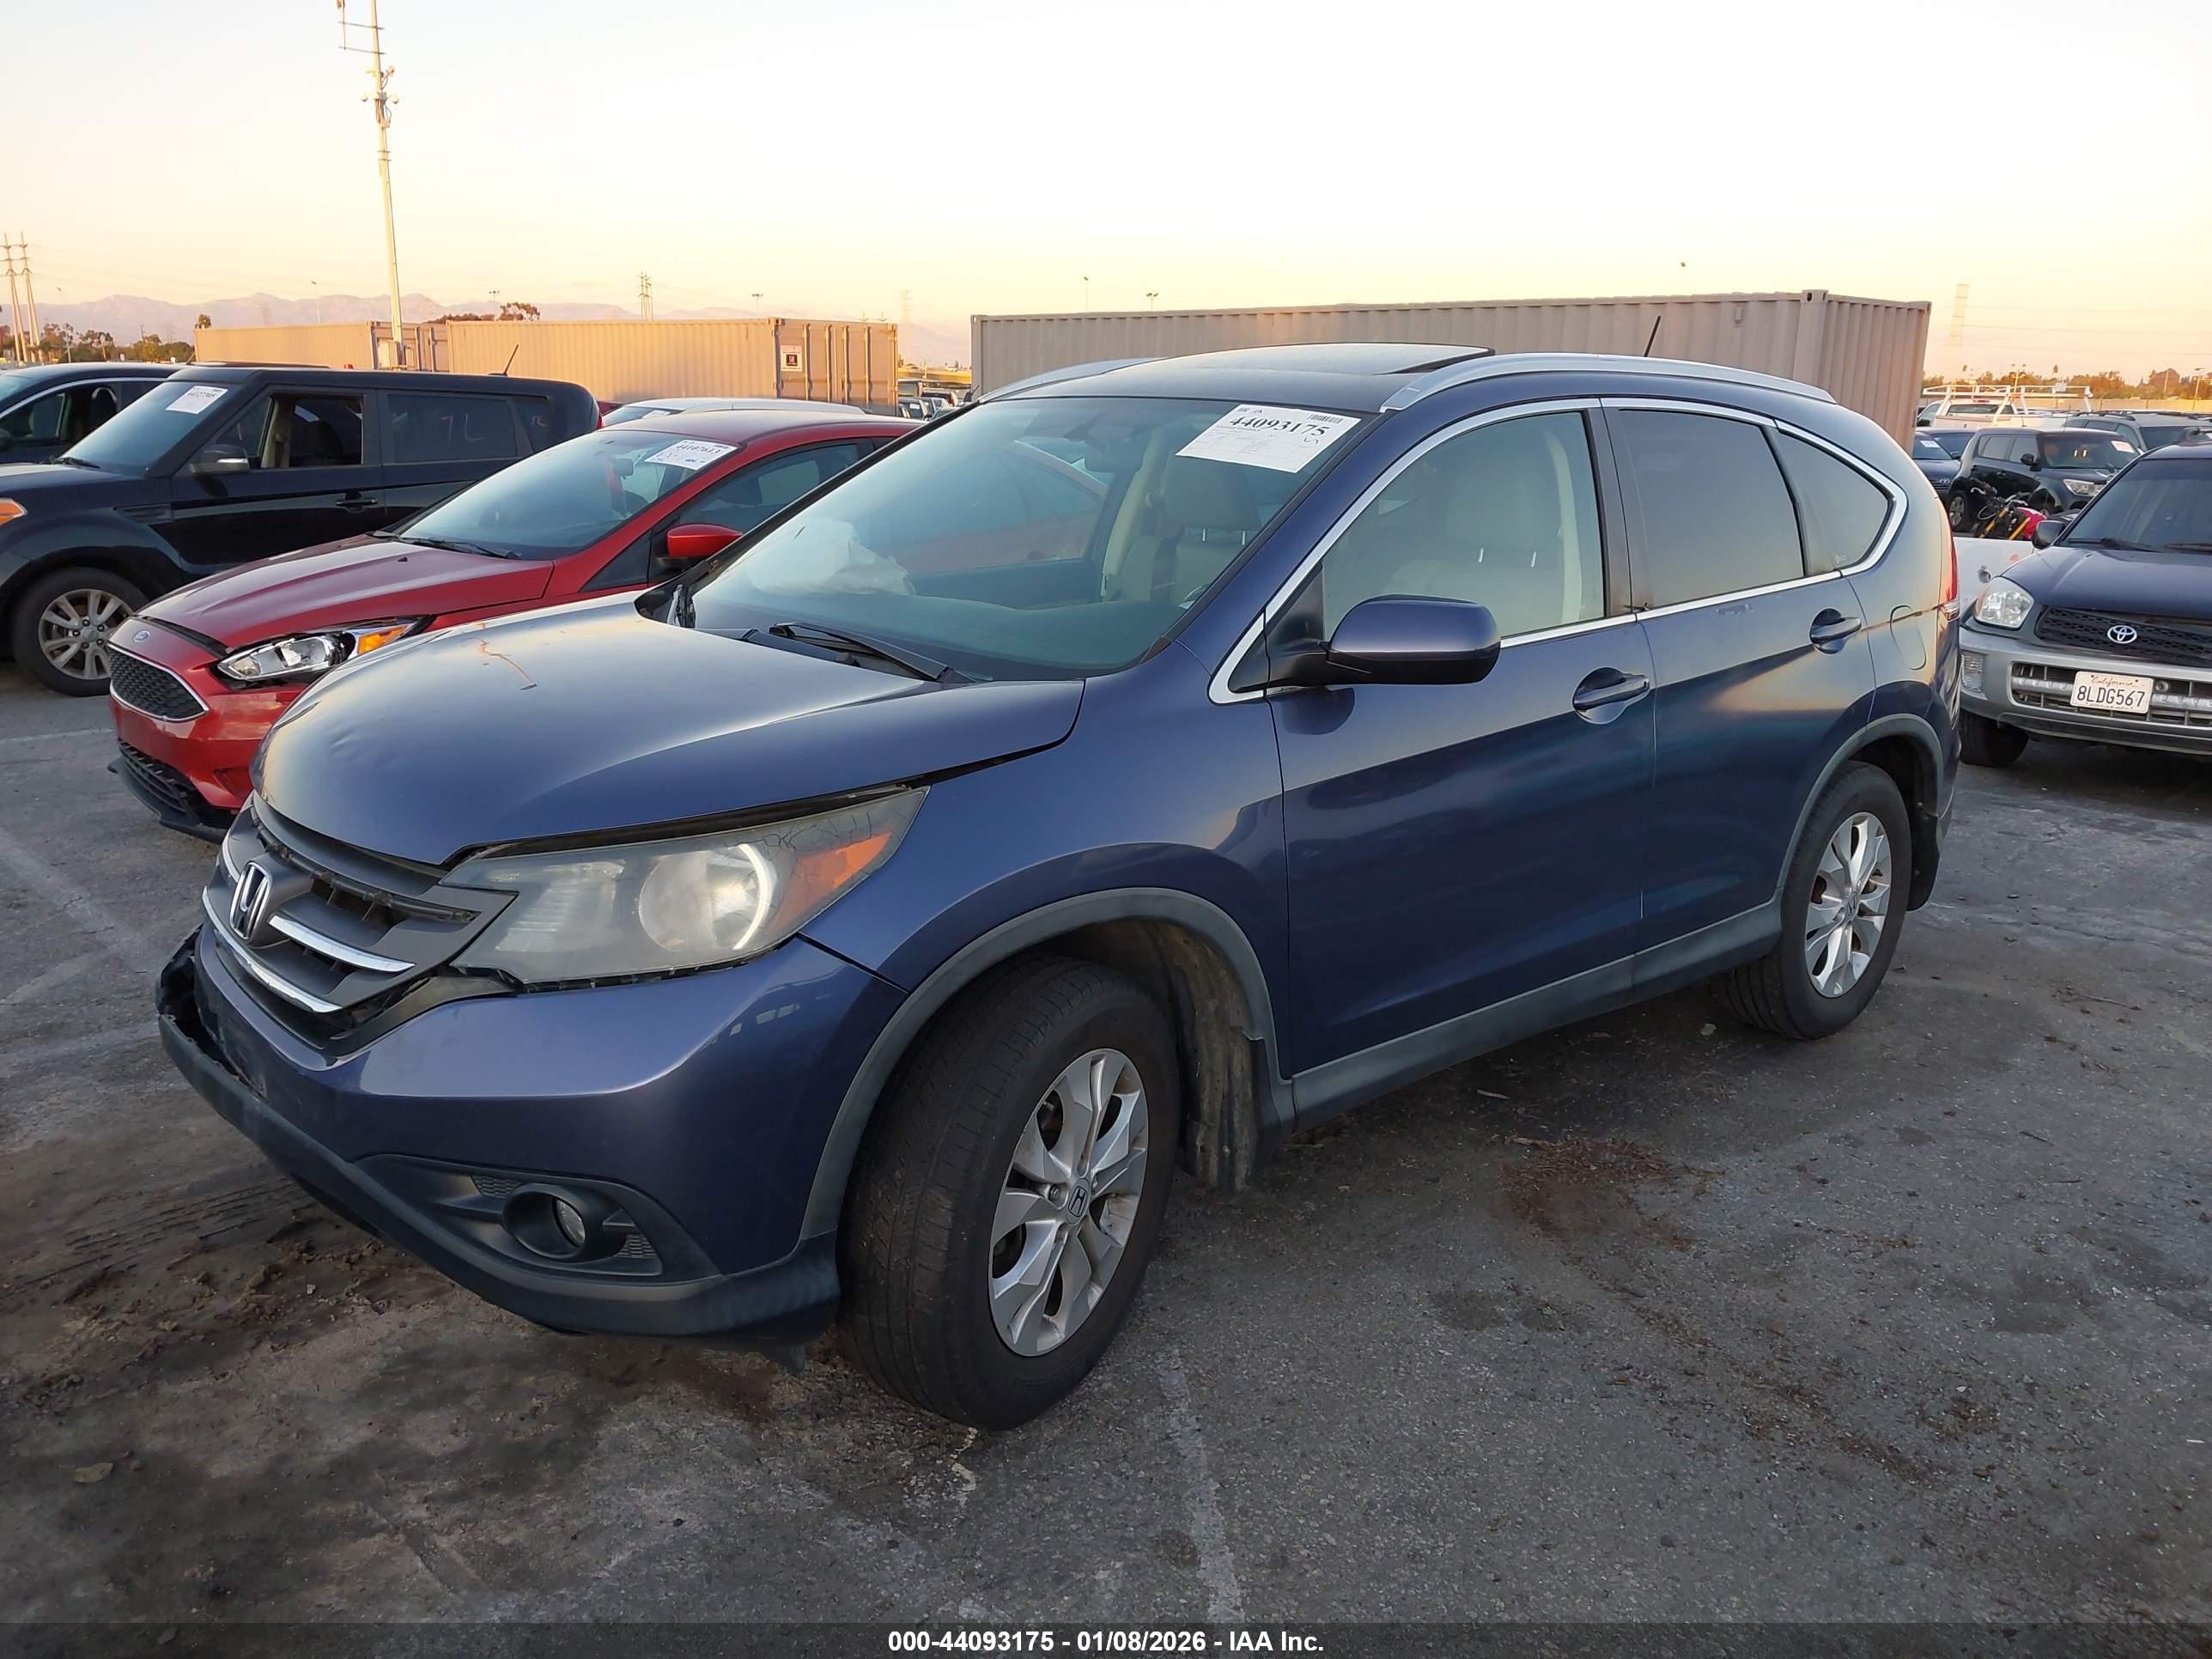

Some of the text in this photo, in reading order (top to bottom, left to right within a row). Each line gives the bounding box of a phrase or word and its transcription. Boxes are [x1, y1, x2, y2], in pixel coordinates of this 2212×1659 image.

[1230, 416, 1330, 436] 44093175
[2091, 676, 2136, 687] California
[2077, 685, 2145, 708] 8LDG567
